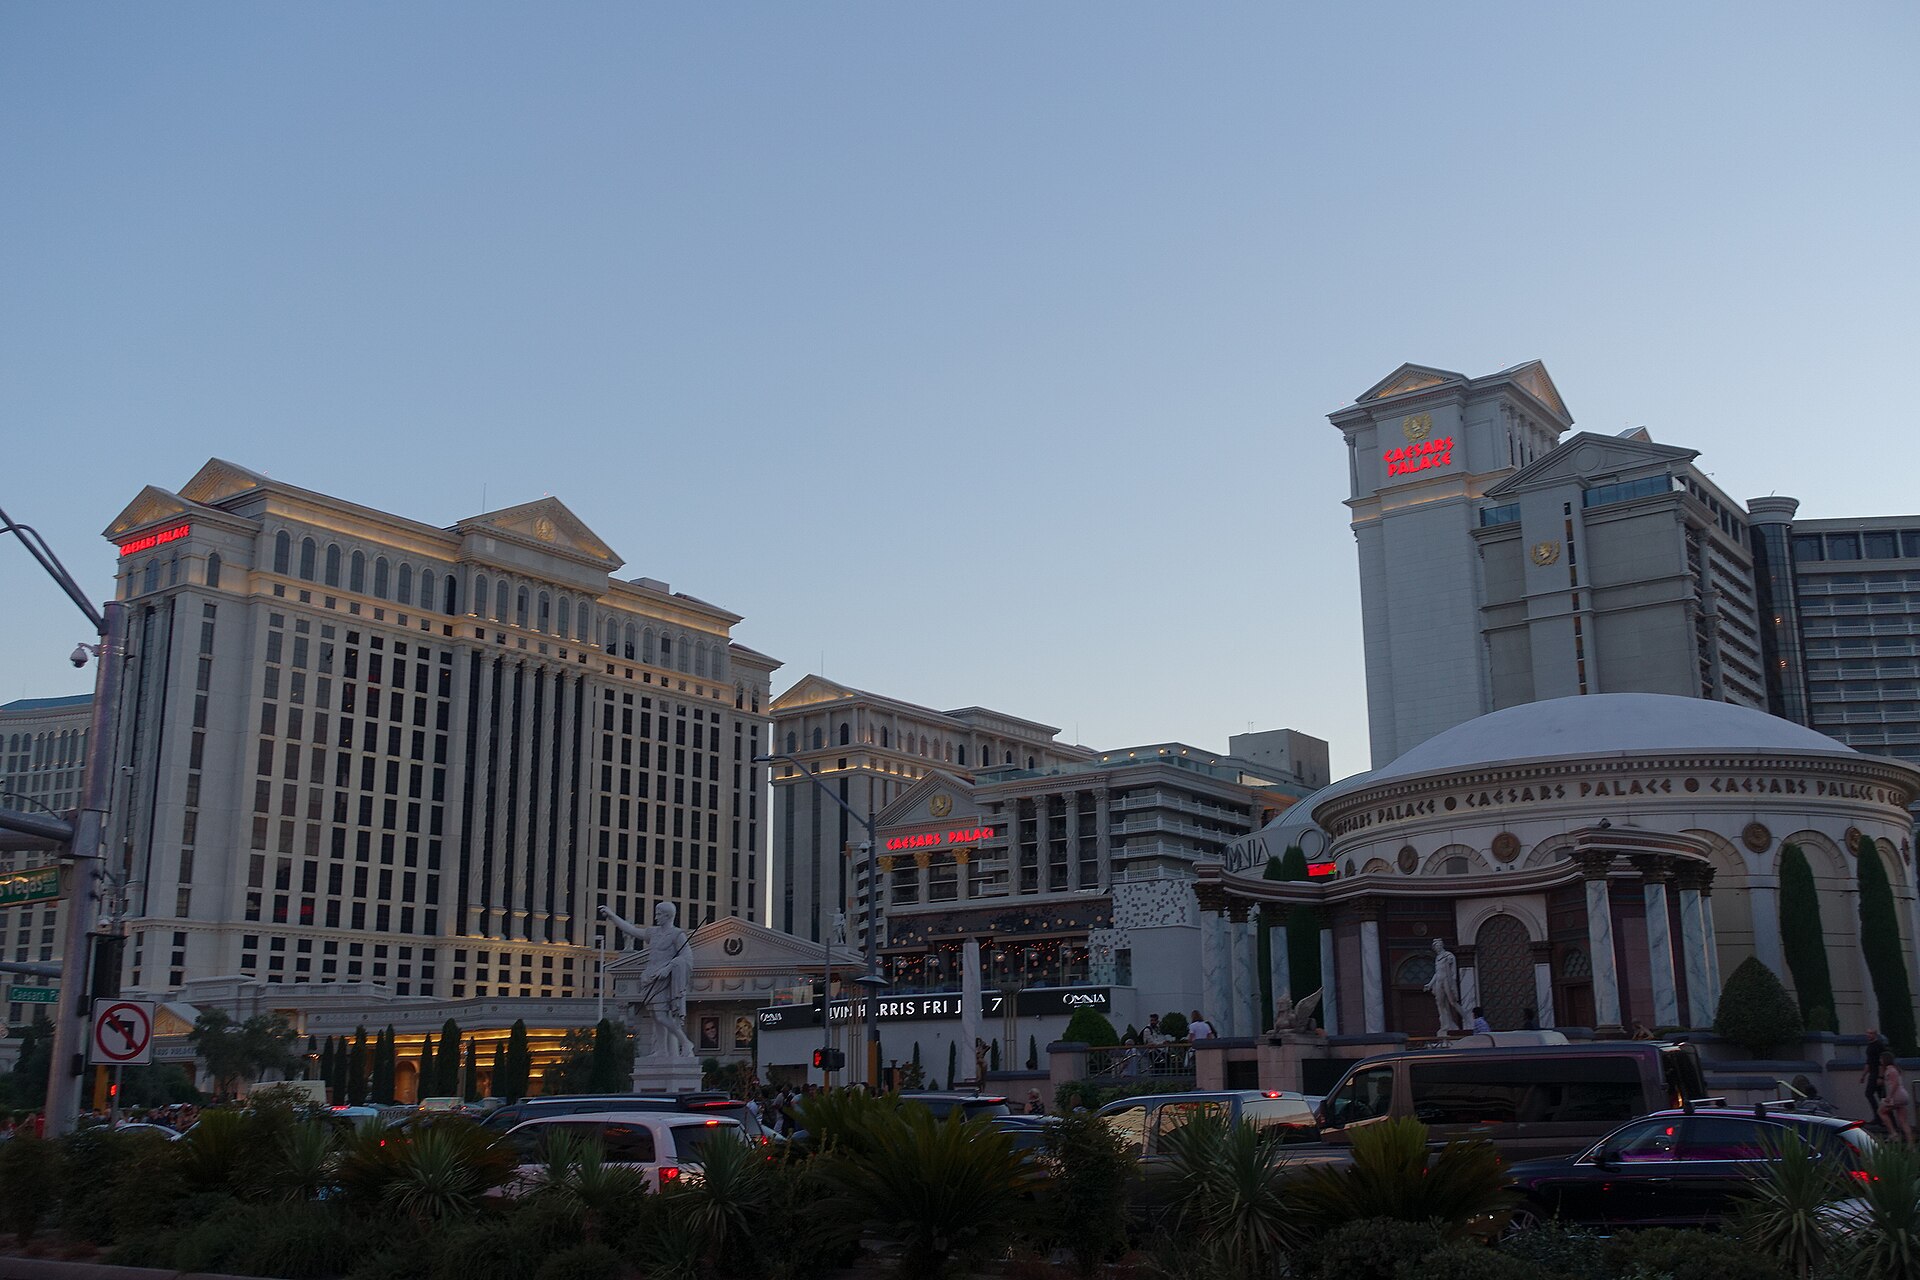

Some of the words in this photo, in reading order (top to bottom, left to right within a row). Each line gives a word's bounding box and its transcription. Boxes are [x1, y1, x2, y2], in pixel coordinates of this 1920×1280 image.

[1383, 436, 1454, 463] CAESARS
[1387, 451, 1451, 477] PALACE
[120, 536, 158, 557] CAESARS
[1378, 799, 1435, 823] PALACE
[1465, 784, 1565, 807] CAESARS
[1580, 779, 1671, 797] PALACE
[1710, 777, 1807, 794] CAESARS
[1817, 780, 1873, 801] PALACE
[886, 833, 941, 851] CAESARS
[12, 989, 46, 1001] Caesars
[857, 1001, 916, 1018] HRRIS
[923, 1000, 948, 1015] FRI
[991, 997, 1003, 1012] 7
